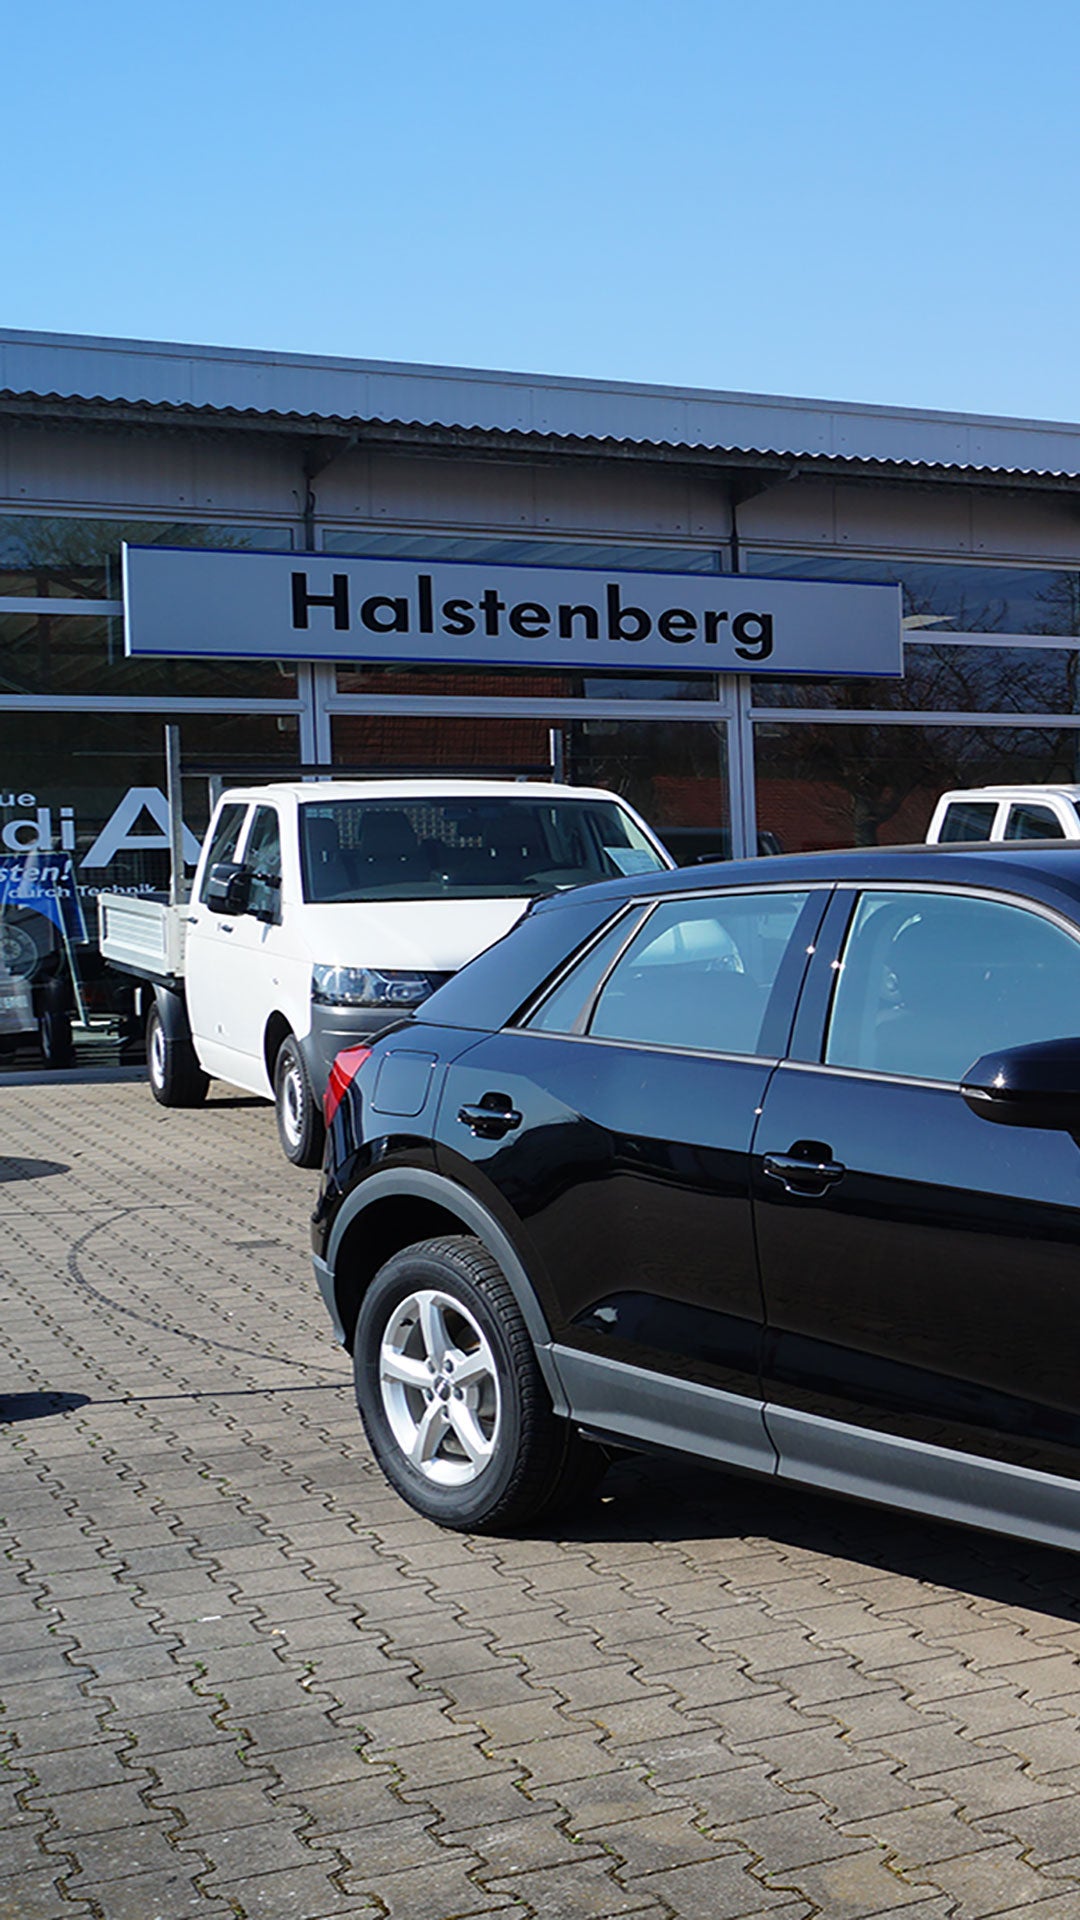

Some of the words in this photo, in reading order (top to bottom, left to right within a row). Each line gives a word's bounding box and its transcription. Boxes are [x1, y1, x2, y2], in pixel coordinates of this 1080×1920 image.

[290, 571, 774, 661] Halstenberg
[2, 807, 75, 851] di
[8, 885, 71, 898] durch
[76, 883, 157, 897] Technik
